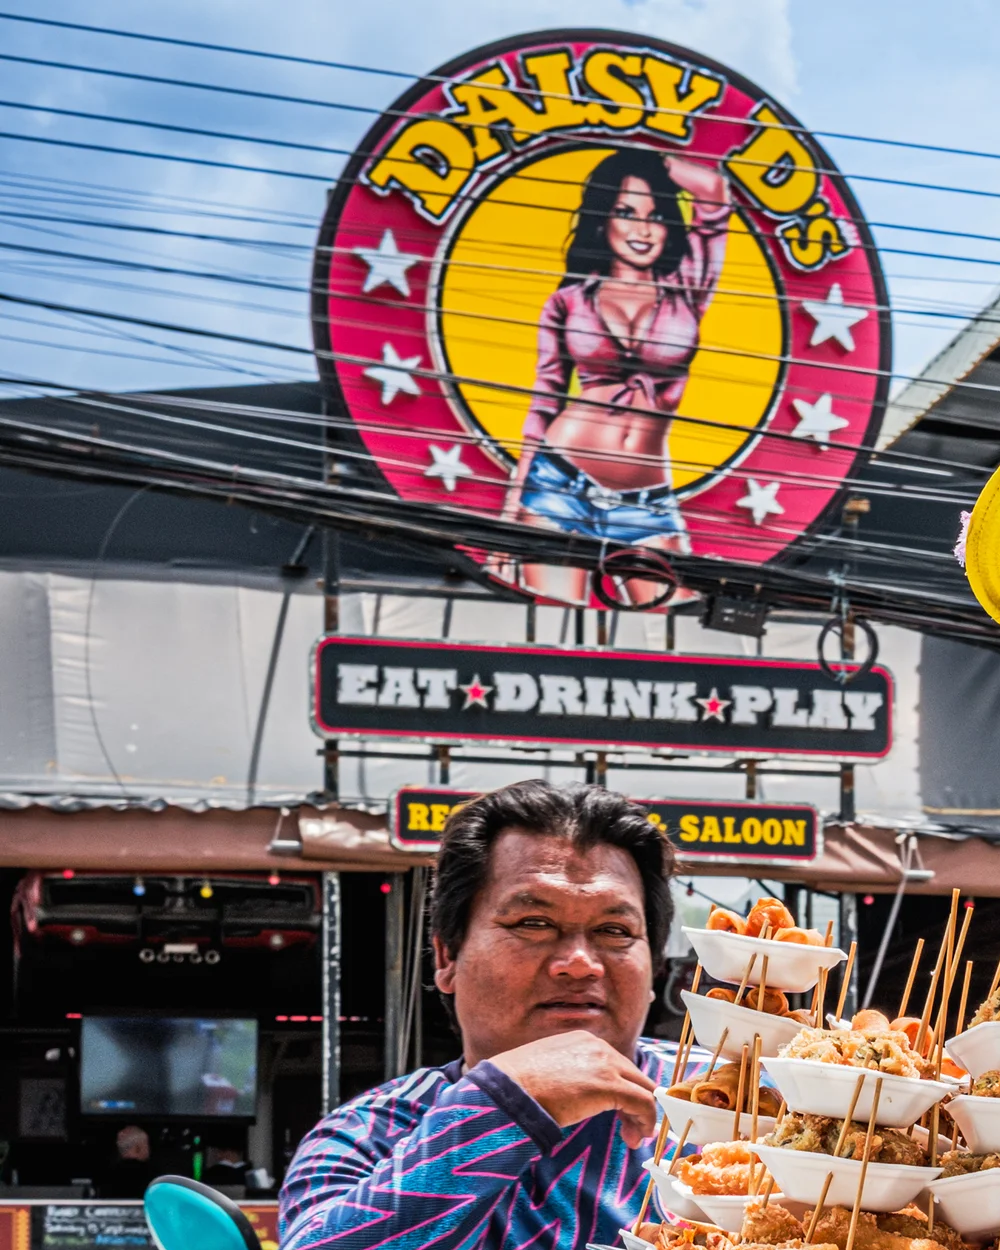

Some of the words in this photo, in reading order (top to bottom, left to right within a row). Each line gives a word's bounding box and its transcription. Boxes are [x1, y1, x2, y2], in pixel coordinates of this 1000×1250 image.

[362, 47, 726, 224] DAISY
[337, 664, 457, 708] EAT
[492, 670, 699, 723] DRINK
[729, 684, 883, 731] PLAY
[679, 814, 807, 846] SALOON
